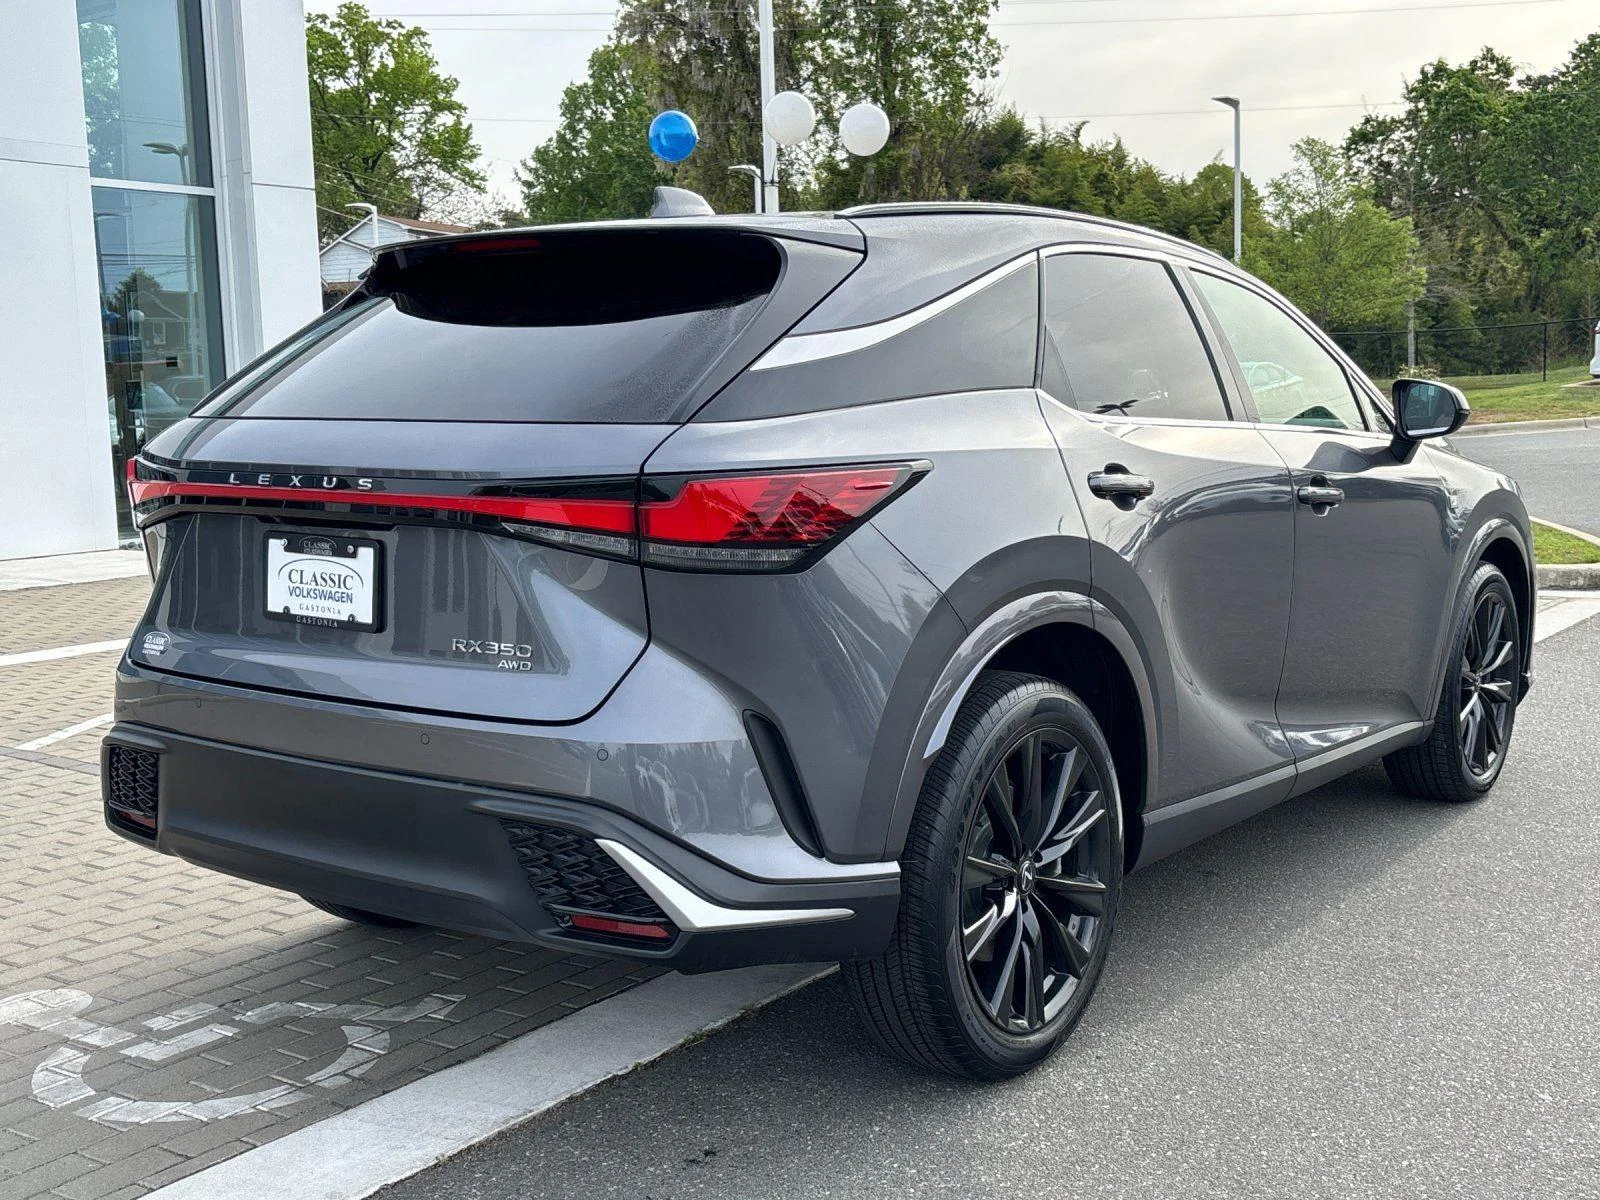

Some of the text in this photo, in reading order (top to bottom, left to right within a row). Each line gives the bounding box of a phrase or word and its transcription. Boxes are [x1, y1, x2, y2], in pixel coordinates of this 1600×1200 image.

[229, 473, 373, 490] LEXUS
[303, 540, 333, 550] CLASSIC
[288, 569, 354, 590] CLASSIC
[288, 586, 353, 604] VOLKSWAGEN
[299, 603, 341, 615] GASTONIA
[296, 615, 338, 628] GASTONIA
[452, 638, 532, 658] RX350
[497, 659, 532, 671] AWD
